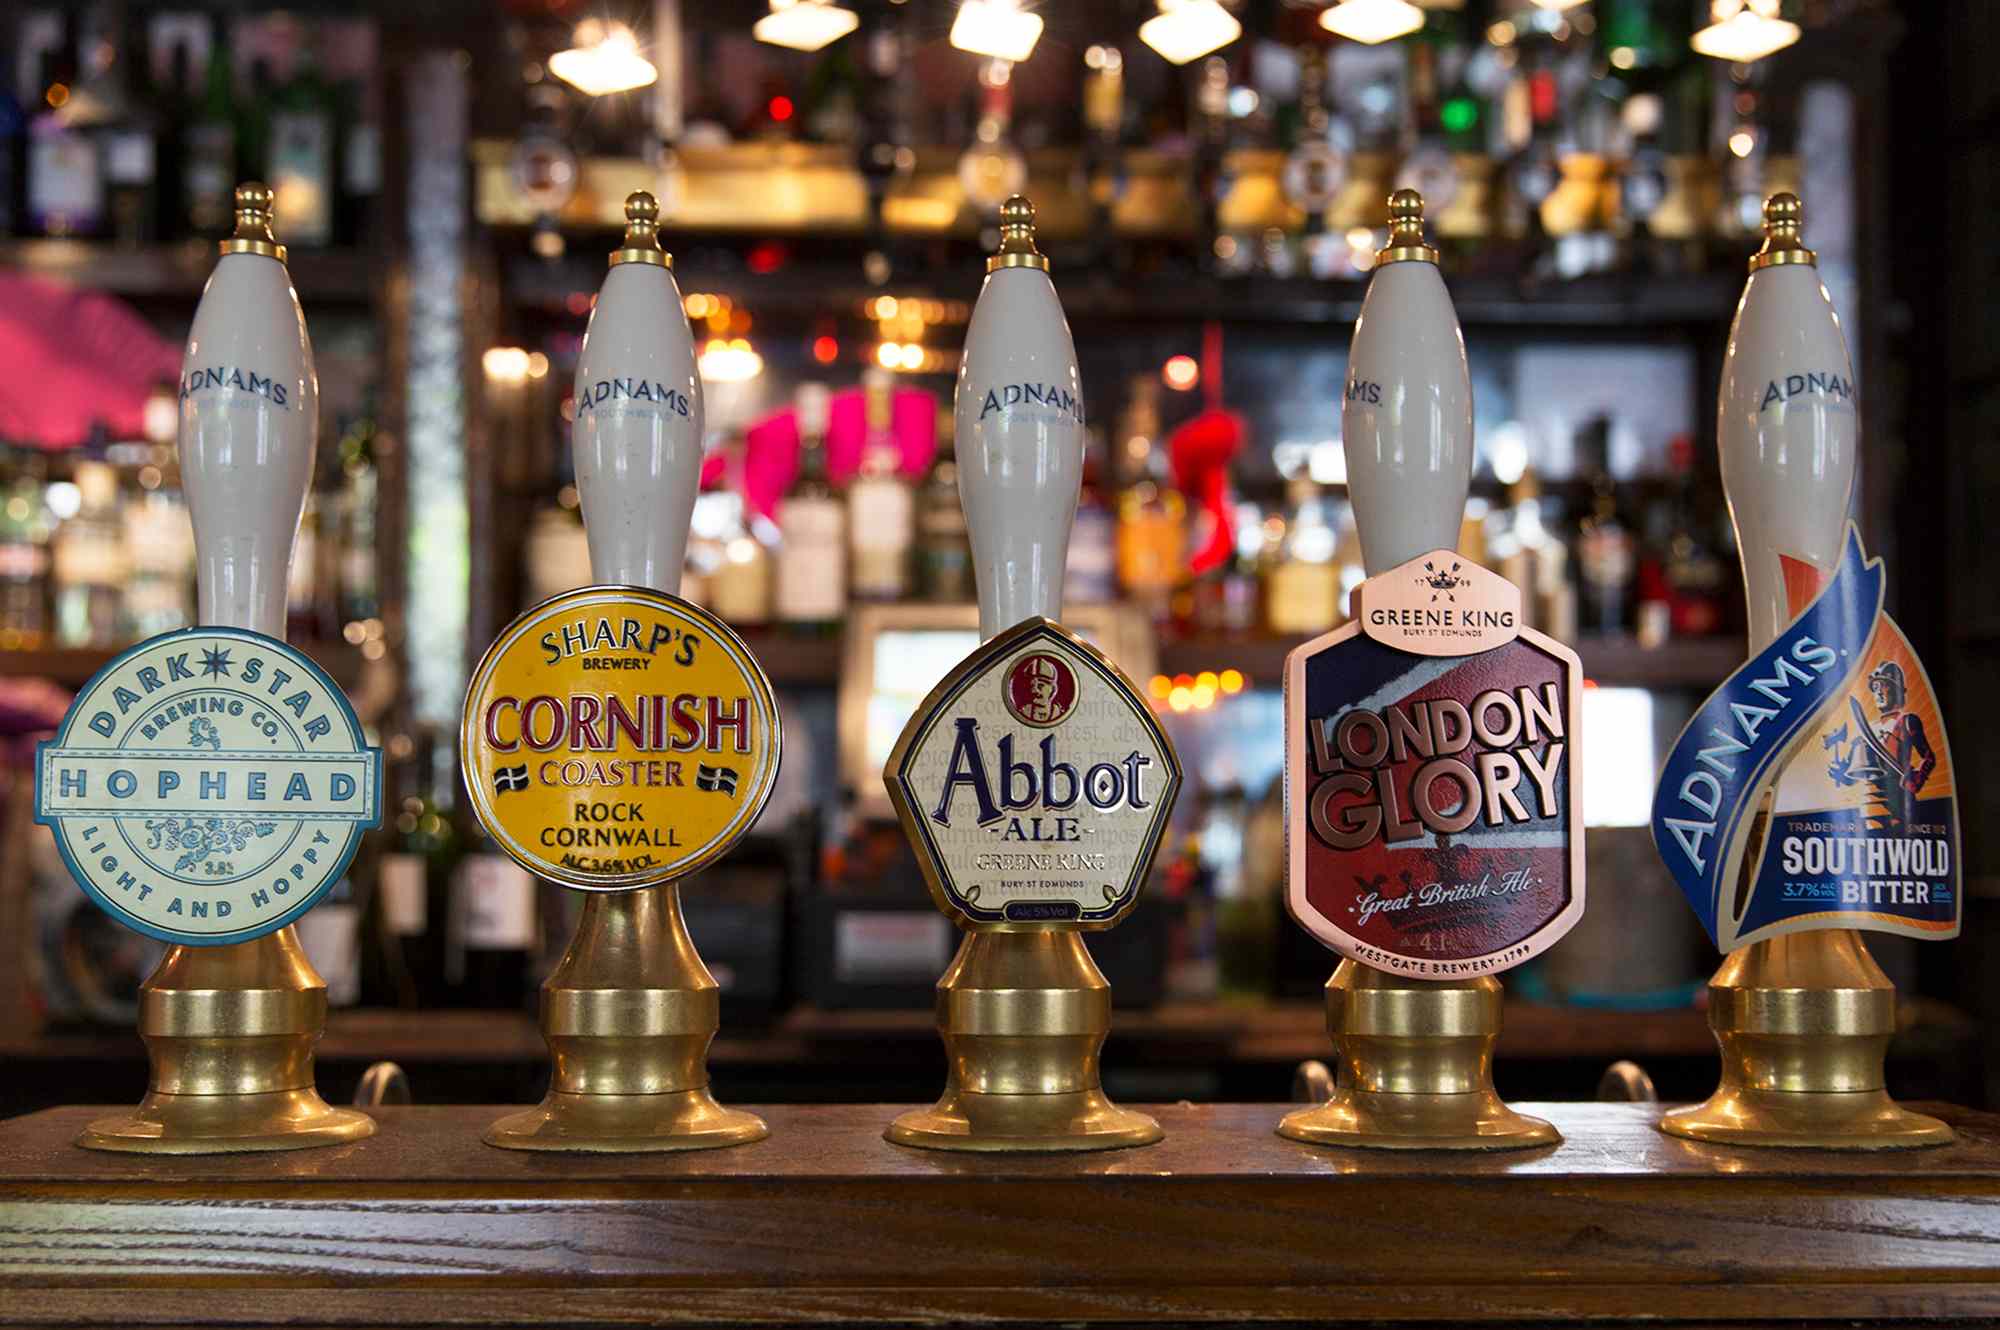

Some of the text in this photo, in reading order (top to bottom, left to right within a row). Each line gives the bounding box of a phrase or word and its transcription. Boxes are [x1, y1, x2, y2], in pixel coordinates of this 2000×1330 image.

[1371, 609, 1514, 627] GREENE KING
[1403, 628, 1483, 638] BURY ST EDMUNDS
[540, 616, 701, 668] SHARP'S
[582, 657, 651, 671] BREWERY
[88, 652, 332, 743] DARK STAR
[140, 696, 245, 741] BREWING
[485, 693, 752, 754] CORNISH
[1308, 681, 1566, 777] LONDON
[59, 769, 357, 802] HOPHEAD
[539, 759, 685, 788] COASTER
[930, 717, 1153, 829] Abbot
[1310, 741, 1566, 851] GLORY
[574, 802, 645, 823] ROCK
[540, 826, 682, 848] CORNWALL
[1001, 817, 1081, 841] ALE
[81, 826, 331, 918] LIGHT AND HOPPY
[976, 853, 1053, 871] GREENE
[1056, 853, 1105, 871] KING
[1782, 836, 1949, 877] SOUTHWOLD
[1001, 880, 1084, 888] BURY ST EDMUNDS
[1356, 867, 1534, 927] Great British Ale
[1783, 882, 1821, 897] 3.7%
[1841, 880, 1930, 905] BITTER
[1352, 942, 1427, 973] WESTGATE
